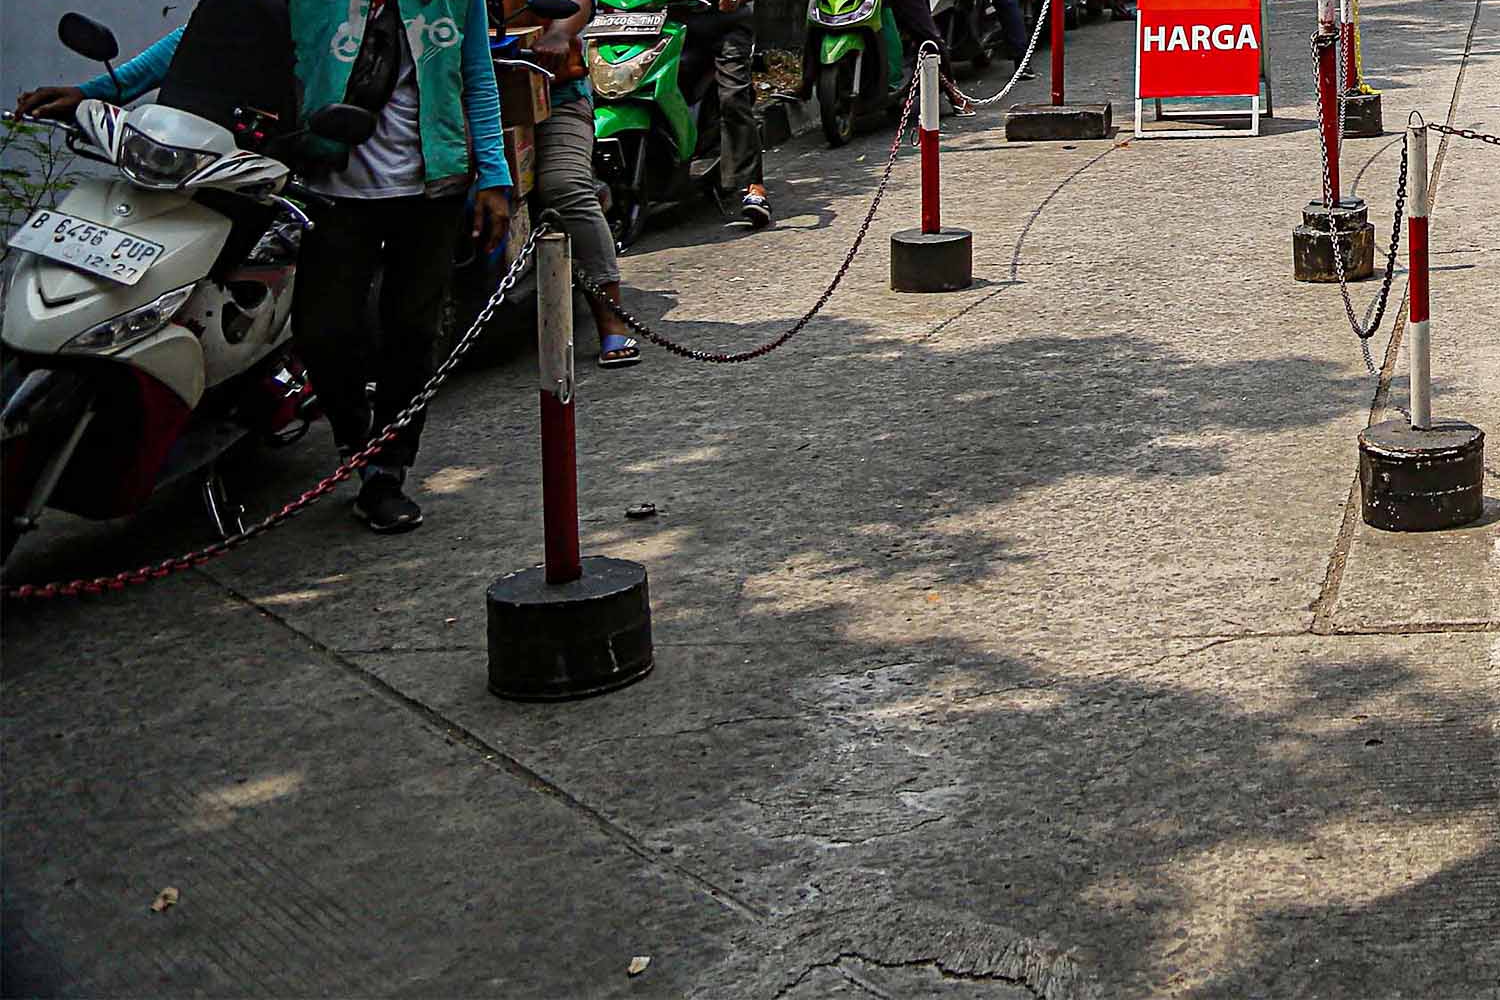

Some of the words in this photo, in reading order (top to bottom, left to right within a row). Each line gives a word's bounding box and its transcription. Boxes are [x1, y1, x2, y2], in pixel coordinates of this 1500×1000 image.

[1143, 24, 1259, 52] HARGA
[32, 212, 50, 229] B
[113, 238, 156, 262] PUP
